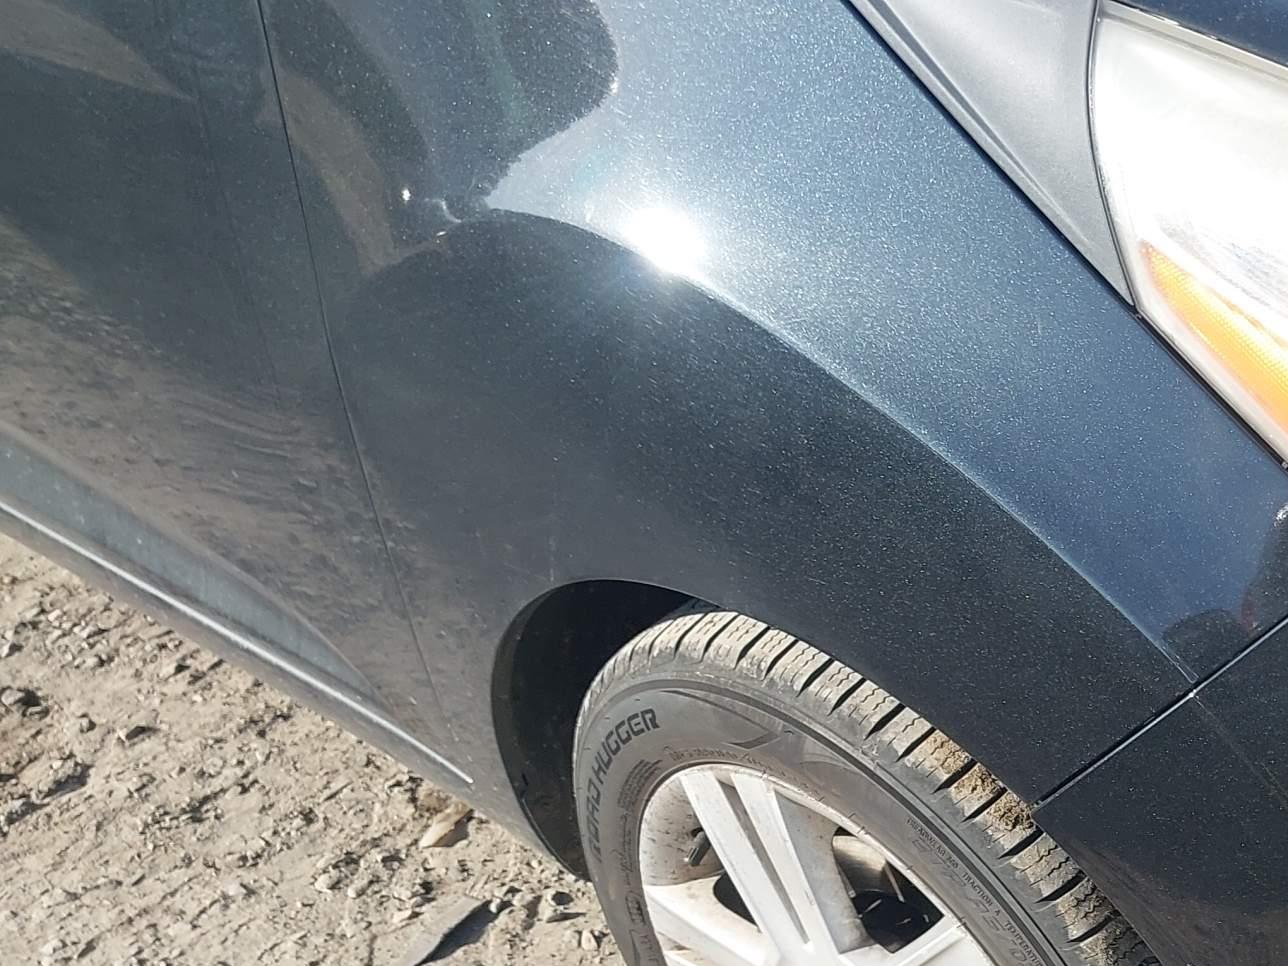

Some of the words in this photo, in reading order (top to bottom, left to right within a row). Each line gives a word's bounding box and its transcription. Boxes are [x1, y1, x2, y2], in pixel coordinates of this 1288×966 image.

[592, 708, 660, 785] HUGGER
[586, 778, 602, 863] ROAD
[962, 872, 993, 907] TRACTION
